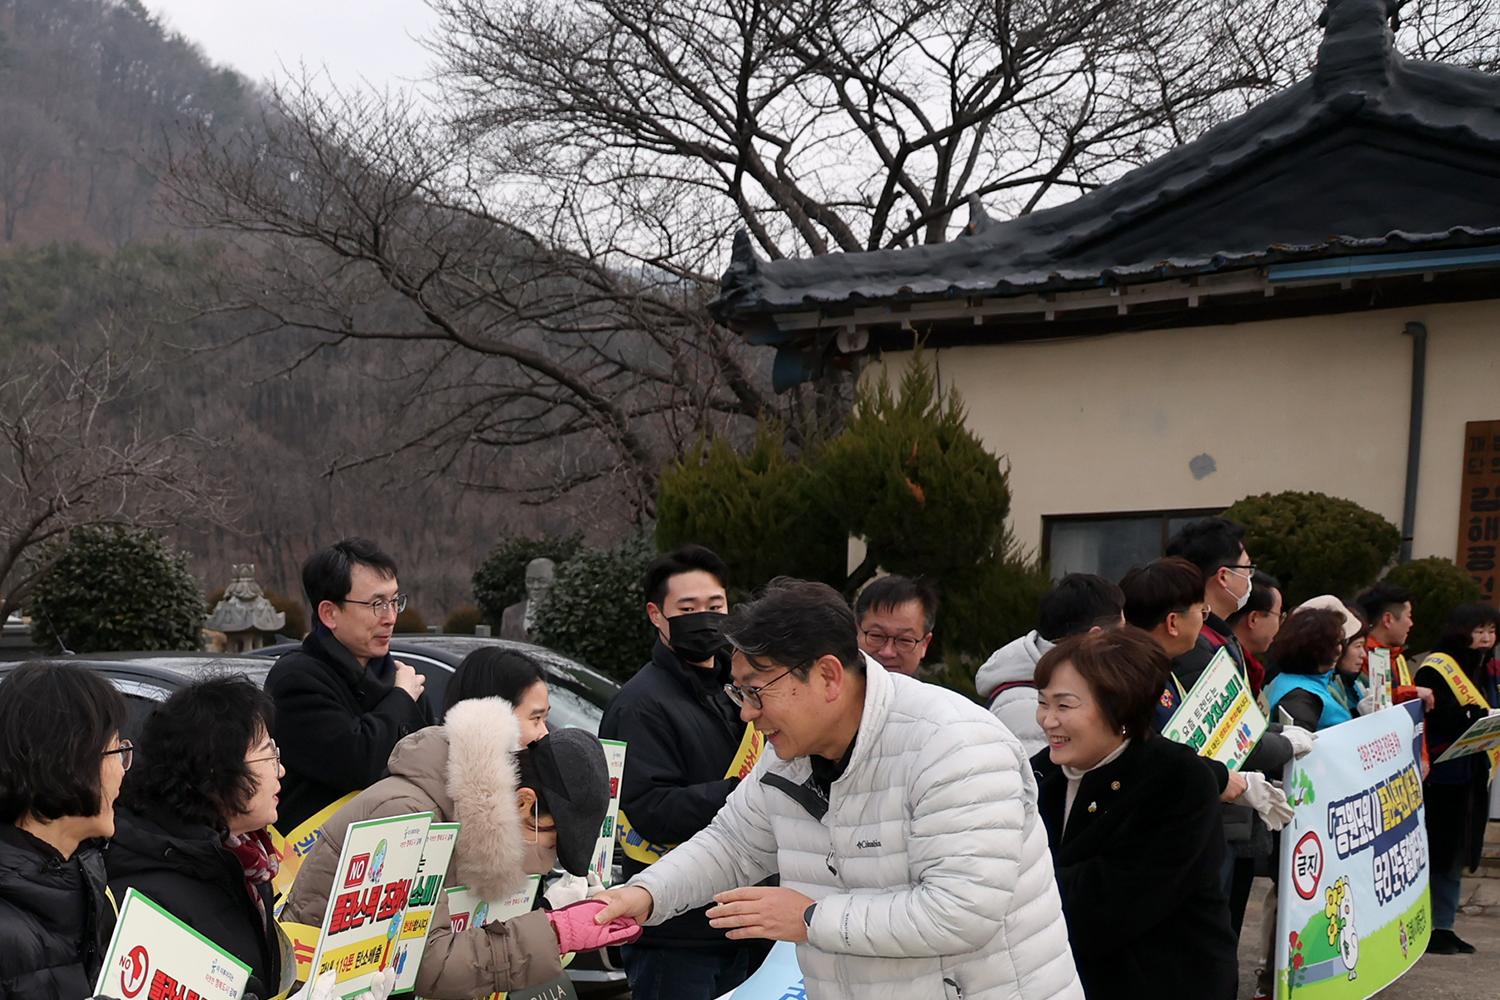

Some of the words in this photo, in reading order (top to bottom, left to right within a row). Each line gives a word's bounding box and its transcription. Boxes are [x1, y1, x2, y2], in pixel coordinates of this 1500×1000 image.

[349, 859, 366, 881] NO
[1297, 853, 1318, 877] 금지
[408, 874, 444, 908] 소비!
[328, 883, 383, 936] 플라스틱
[376, 878, 413, 922] 조화!
[450, 917, 465, 934] NO
[119, 954, 131, 971] NO
